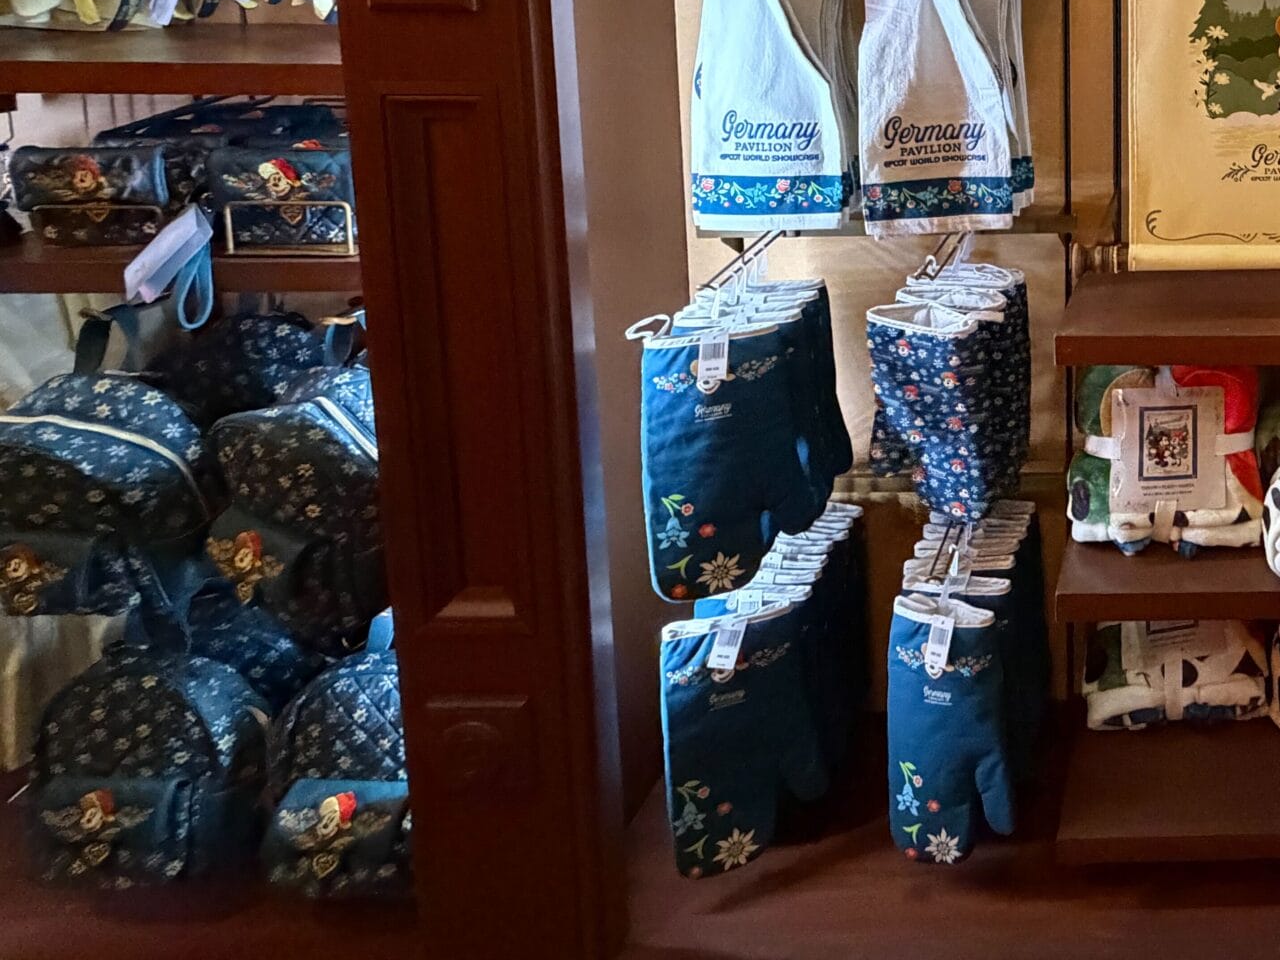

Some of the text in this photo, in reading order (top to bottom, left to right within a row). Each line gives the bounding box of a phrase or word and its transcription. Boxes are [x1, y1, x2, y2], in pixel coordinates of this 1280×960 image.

[721, 110, 820, 151] Germany
[884, 116, 985, 151] Germany
[735, 142, 792, 152] PAVILION
[900, 143, 961, 156] PAVILION
[884, 155, 986, 167] EPCOT WORLD SHOWCASE
